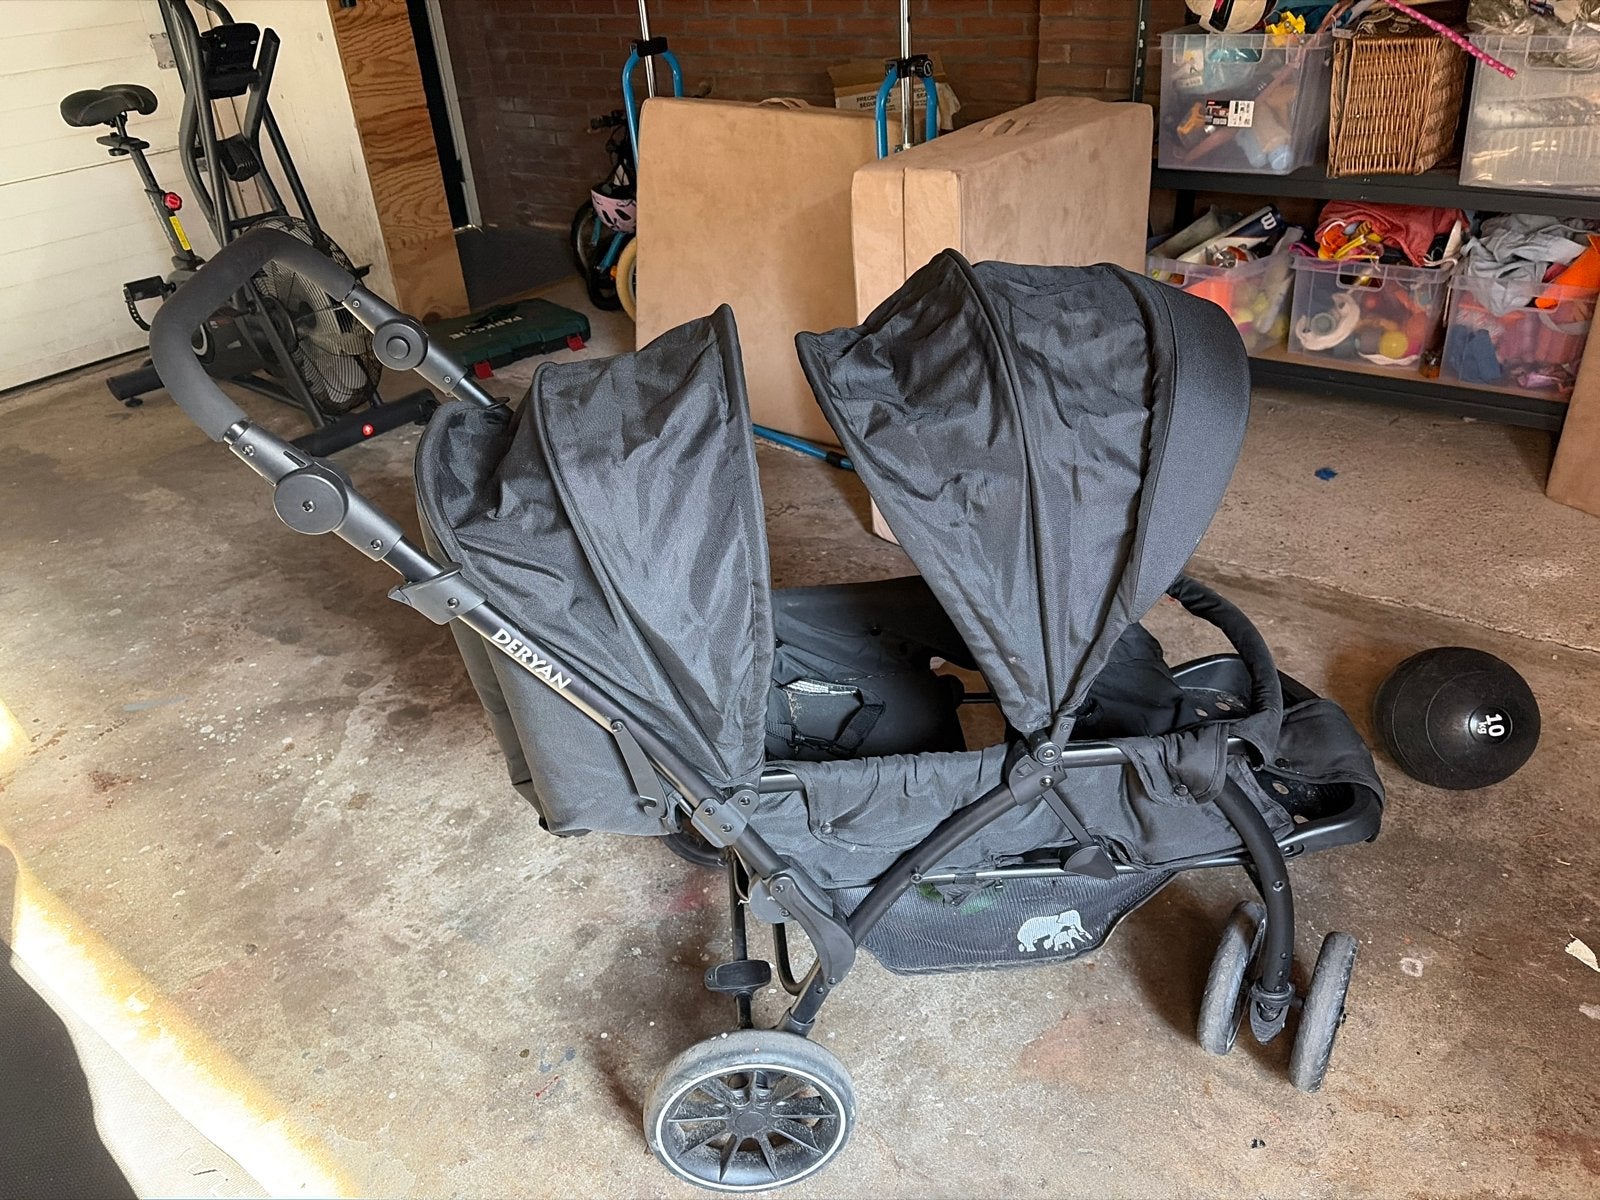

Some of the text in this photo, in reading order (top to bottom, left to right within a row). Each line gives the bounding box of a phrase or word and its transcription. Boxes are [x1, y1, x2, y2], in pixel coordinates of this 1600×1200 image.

[491, 628, 572, 690] DERYAN
[1477, 721, 1487, 734] kg
[1486, 714, 1504, 736] 10
